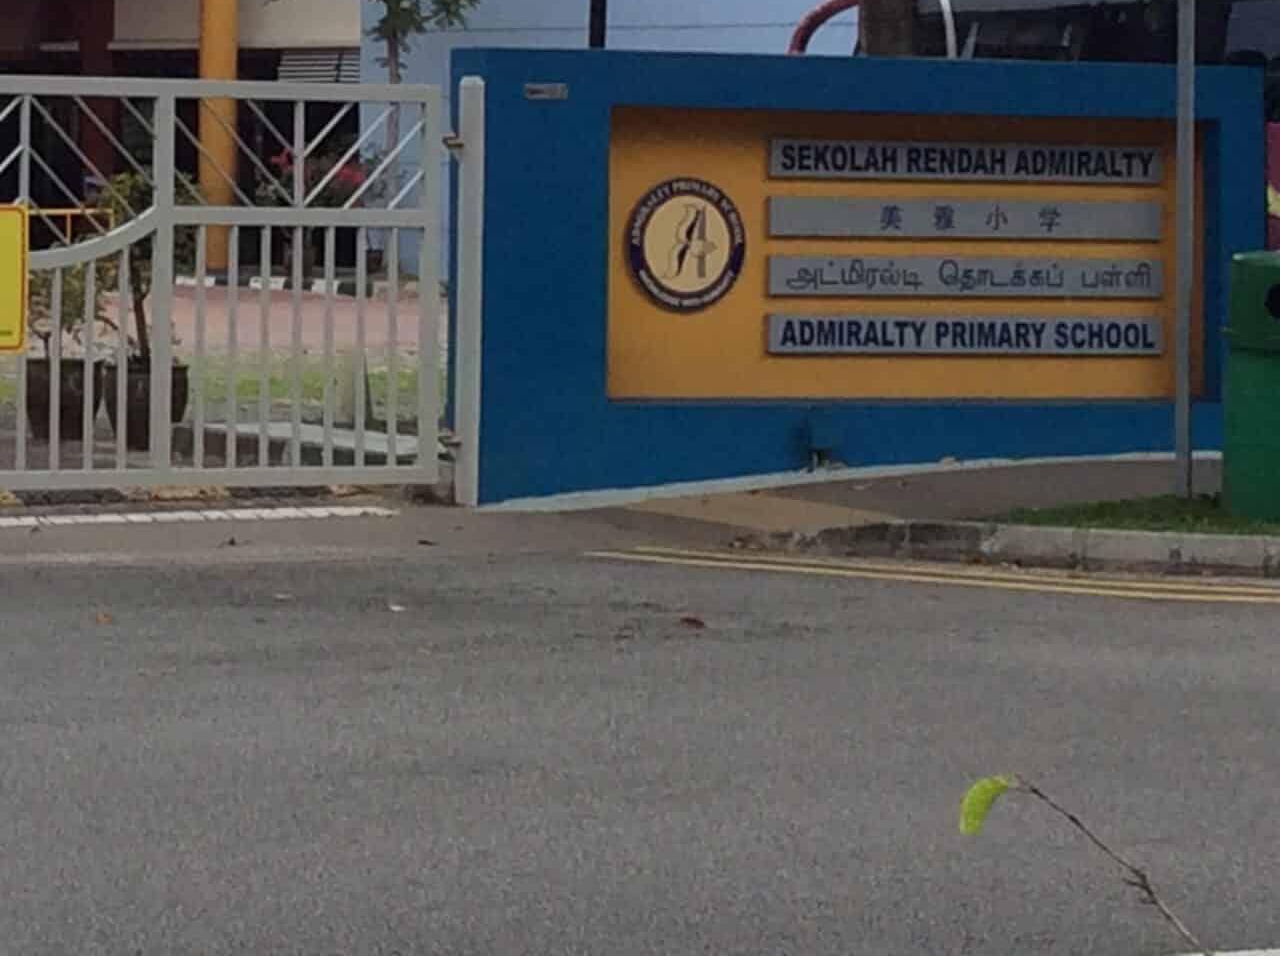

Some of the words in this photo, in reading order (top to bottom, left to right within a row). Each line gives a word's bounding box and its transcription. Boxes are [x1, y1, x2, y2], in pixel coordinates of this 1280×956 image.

[781, 144, 897, 173] SEKOLAH
[907, 146, 1006, 175] RENDAH
[1014, 149, 1154, 178] ADMIRALTY
[1081, 260, 1152, 290] பள்ளி
[781, 320, 926, 347] ADMIRALTY
[935, 321, 1046, 349] PRIMARY
[1054, 322, 1155, 349] SCHOOL
